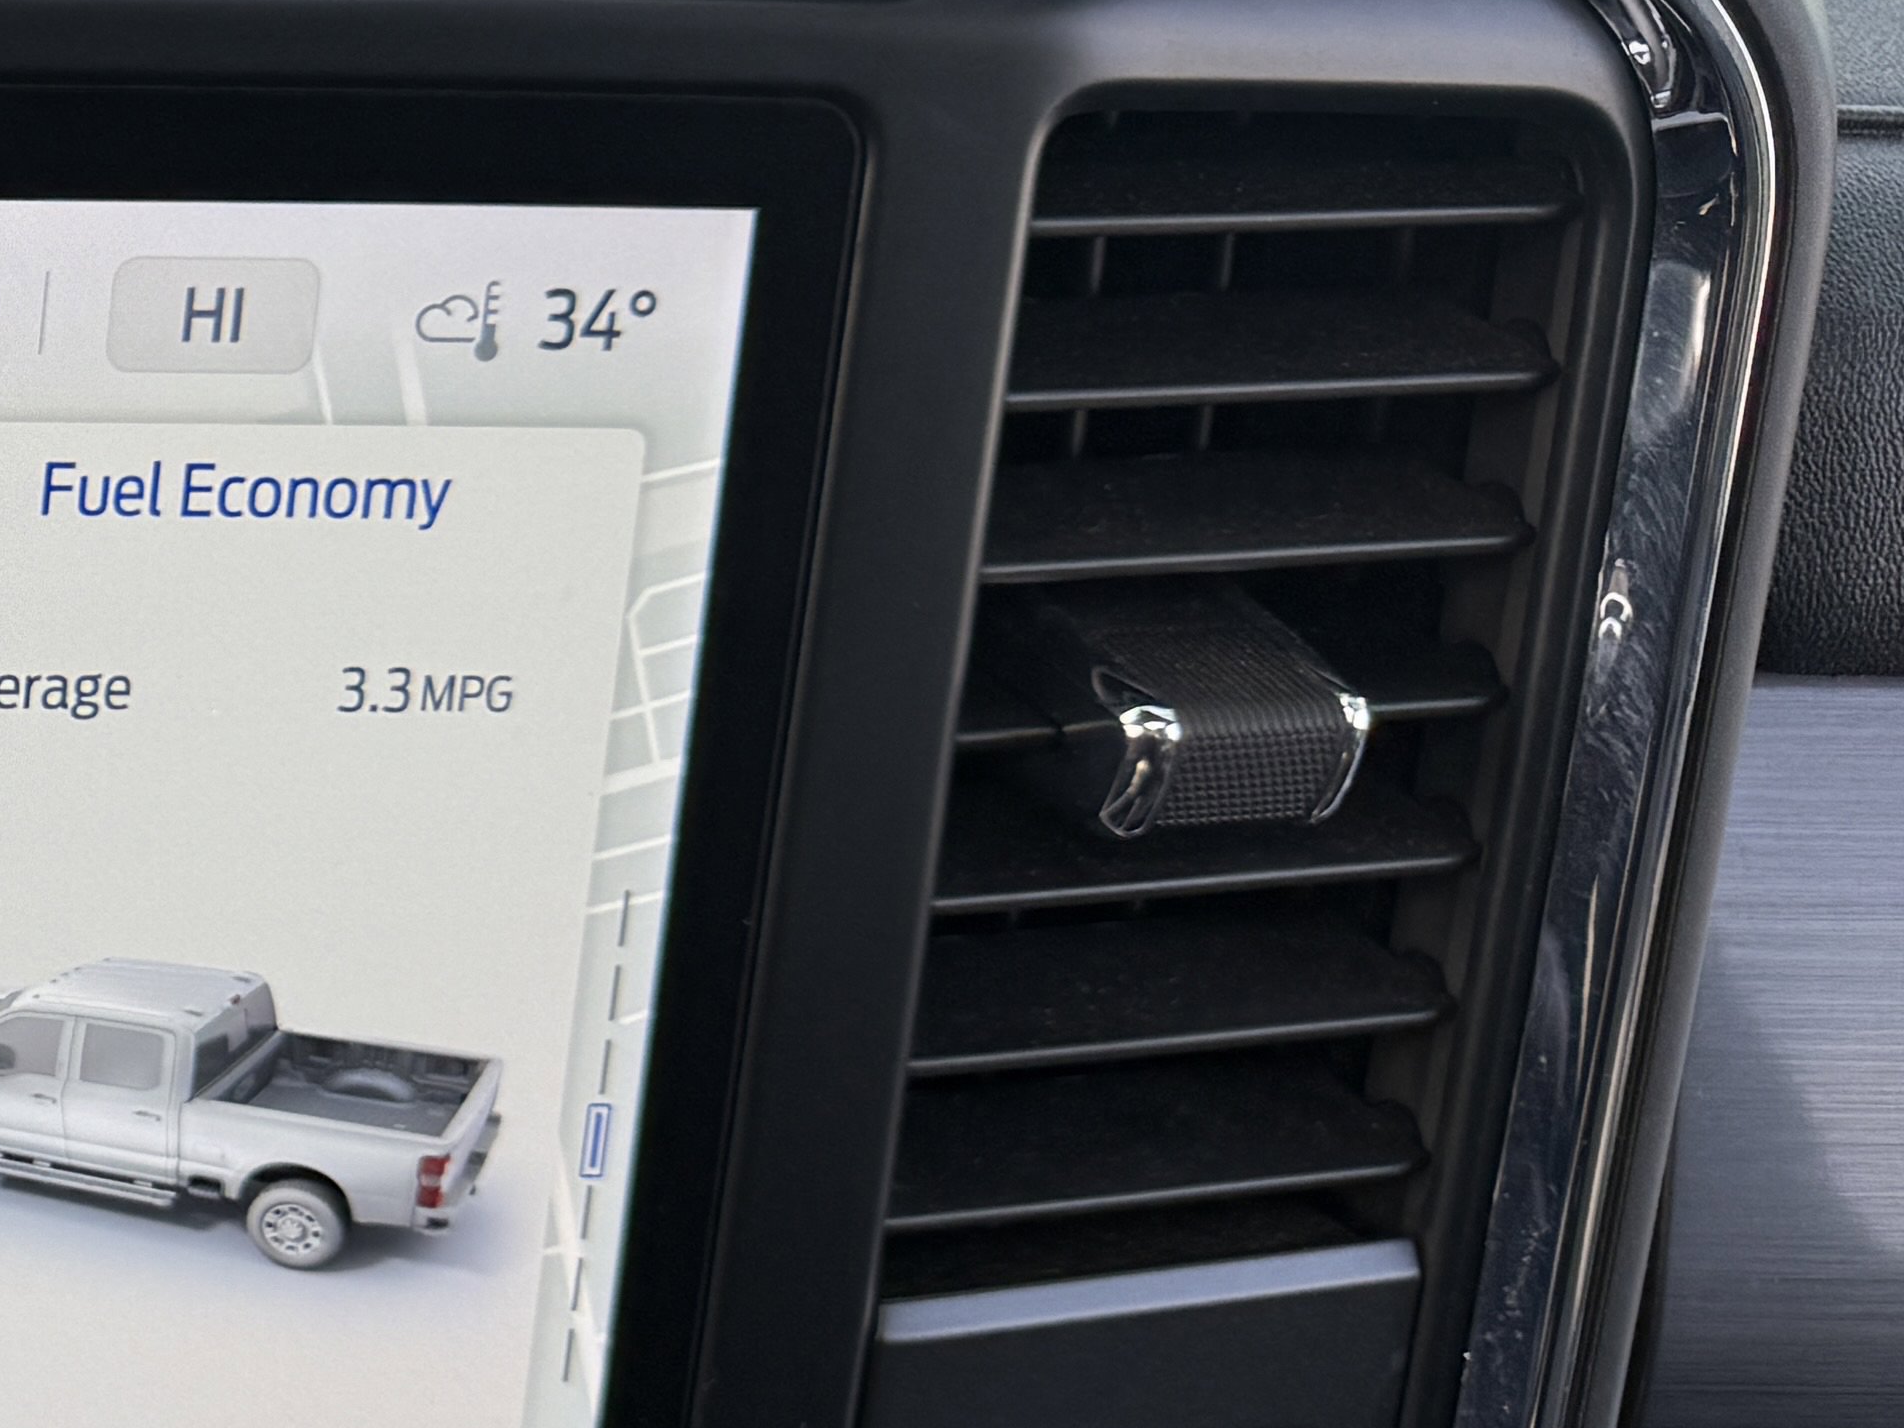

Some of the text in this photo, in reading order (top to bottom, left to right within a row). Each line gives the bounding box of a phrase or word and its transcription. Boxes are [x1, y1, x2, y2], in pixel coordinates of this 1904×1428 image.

[180, 285, 245, 344] HI
[536, 286, 658, 353] 34°
[40, 460, 453, 530] Fuel Economy
